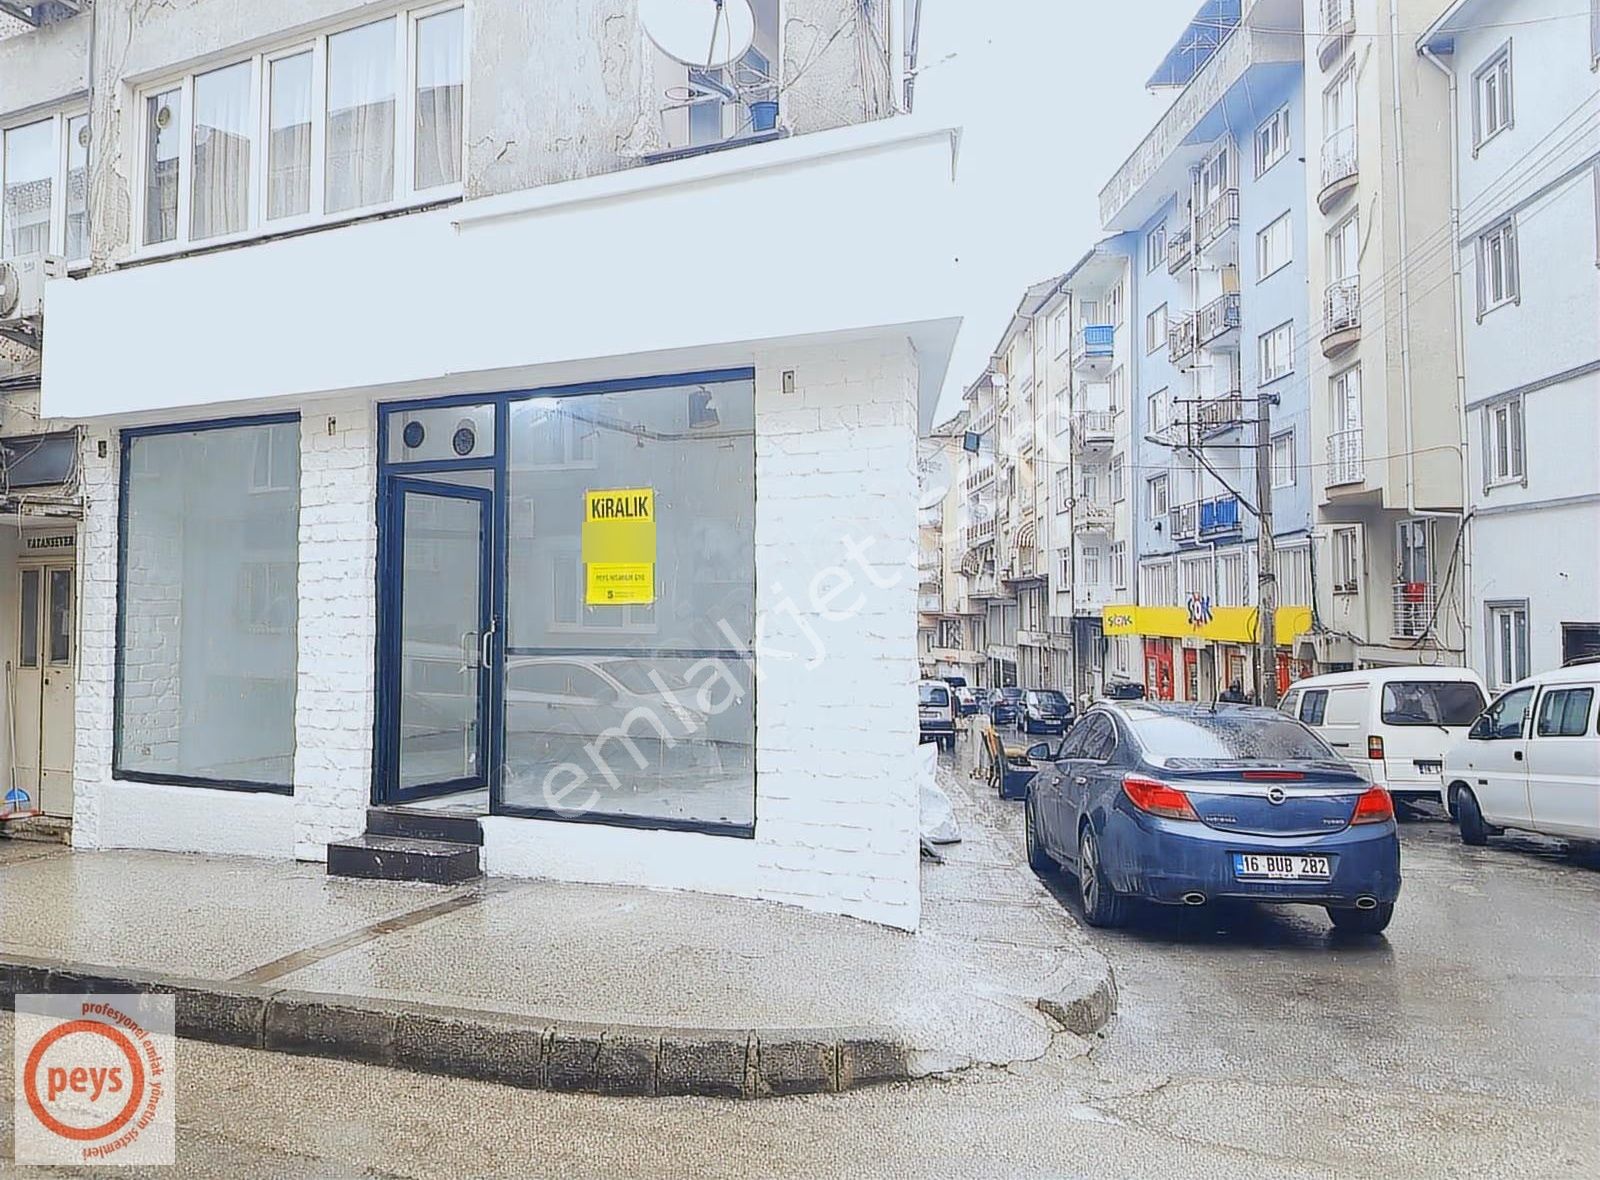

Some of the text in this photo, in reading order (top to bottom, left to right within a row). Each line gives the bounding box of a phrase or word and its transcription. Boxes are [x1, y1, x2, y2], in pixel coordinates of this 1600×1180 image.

[1244, 855, 1327, 875] 16 BUB 282
